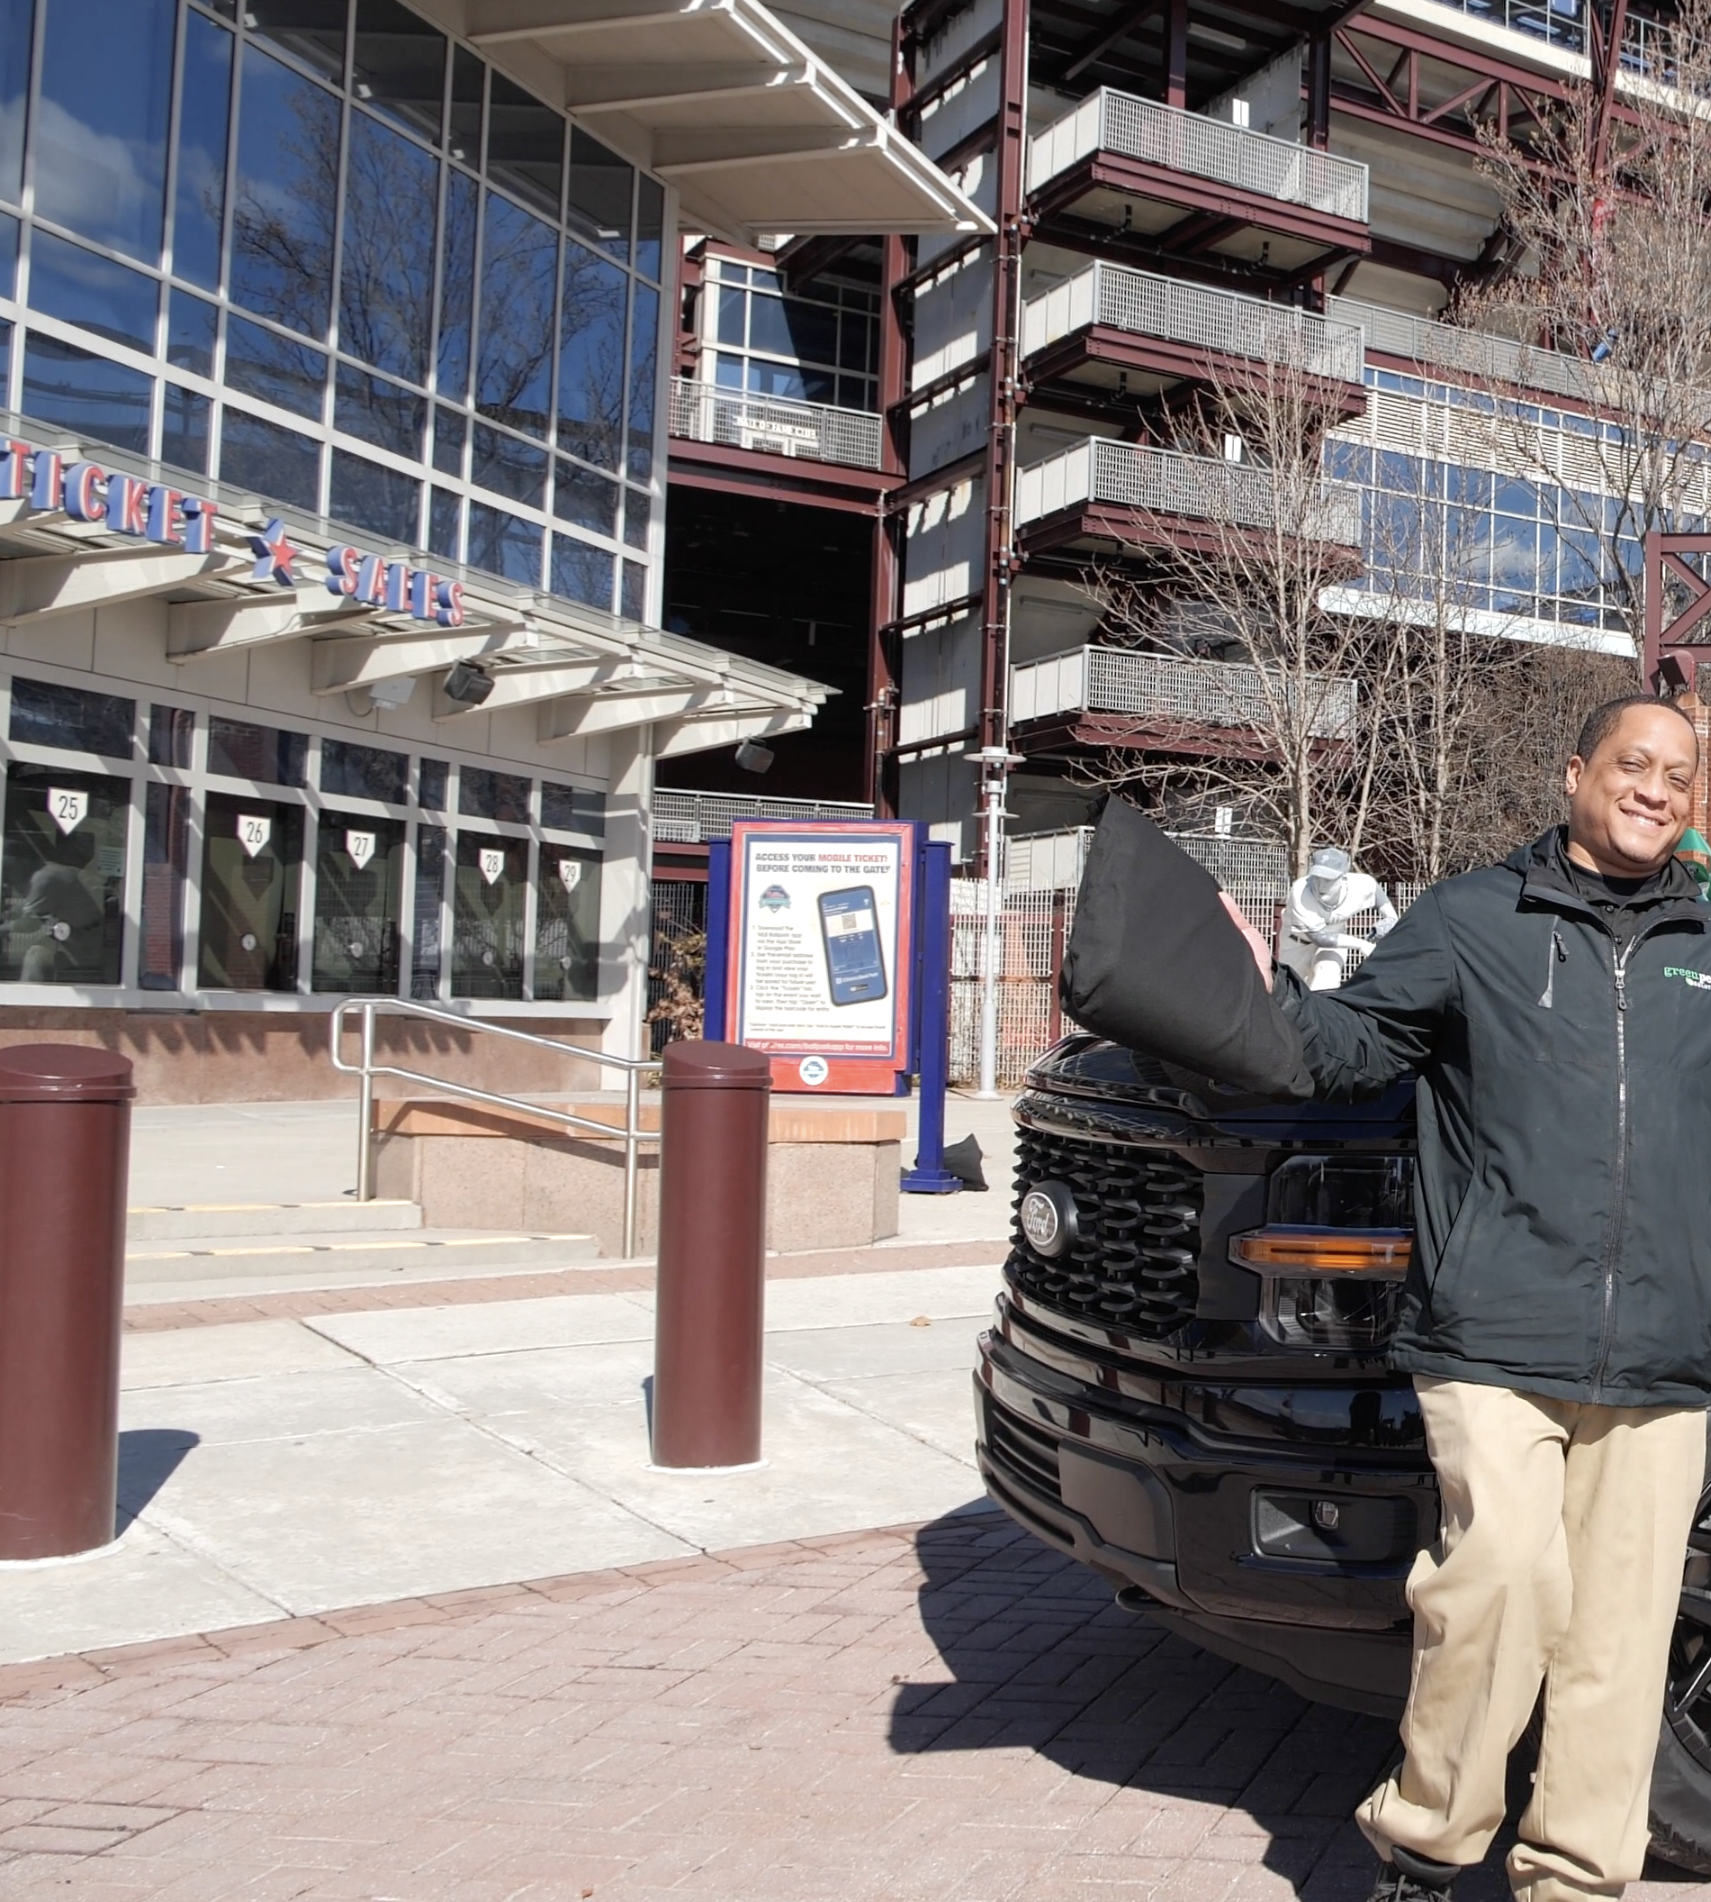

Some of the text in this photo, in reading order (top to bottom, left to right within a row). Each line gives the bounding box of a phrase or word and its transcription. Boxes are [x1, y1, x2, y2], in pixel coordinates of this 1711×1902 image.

[0, 438, 464, 627] TICKET SALES
[58, 795, 78, 821] 25
[246, 822, 264, 844] 26
[354, 836, 369, 857] 27
[486, 854, 499, 873] 28
[755, 853, 789, 861] ACCESS
[792, 853, 815, 862] YOUR
[818, 854, 851, 862] MOBILE
[564, 864, 577, 883] 29
[756, 864, 789, 872] BEFORE
[792, 865, 828, 873] COMING
[830, 865, 841, 873] TO
[844, 865, 860, 873] THE
[1026, 1198, 1050, 1236] Ford
